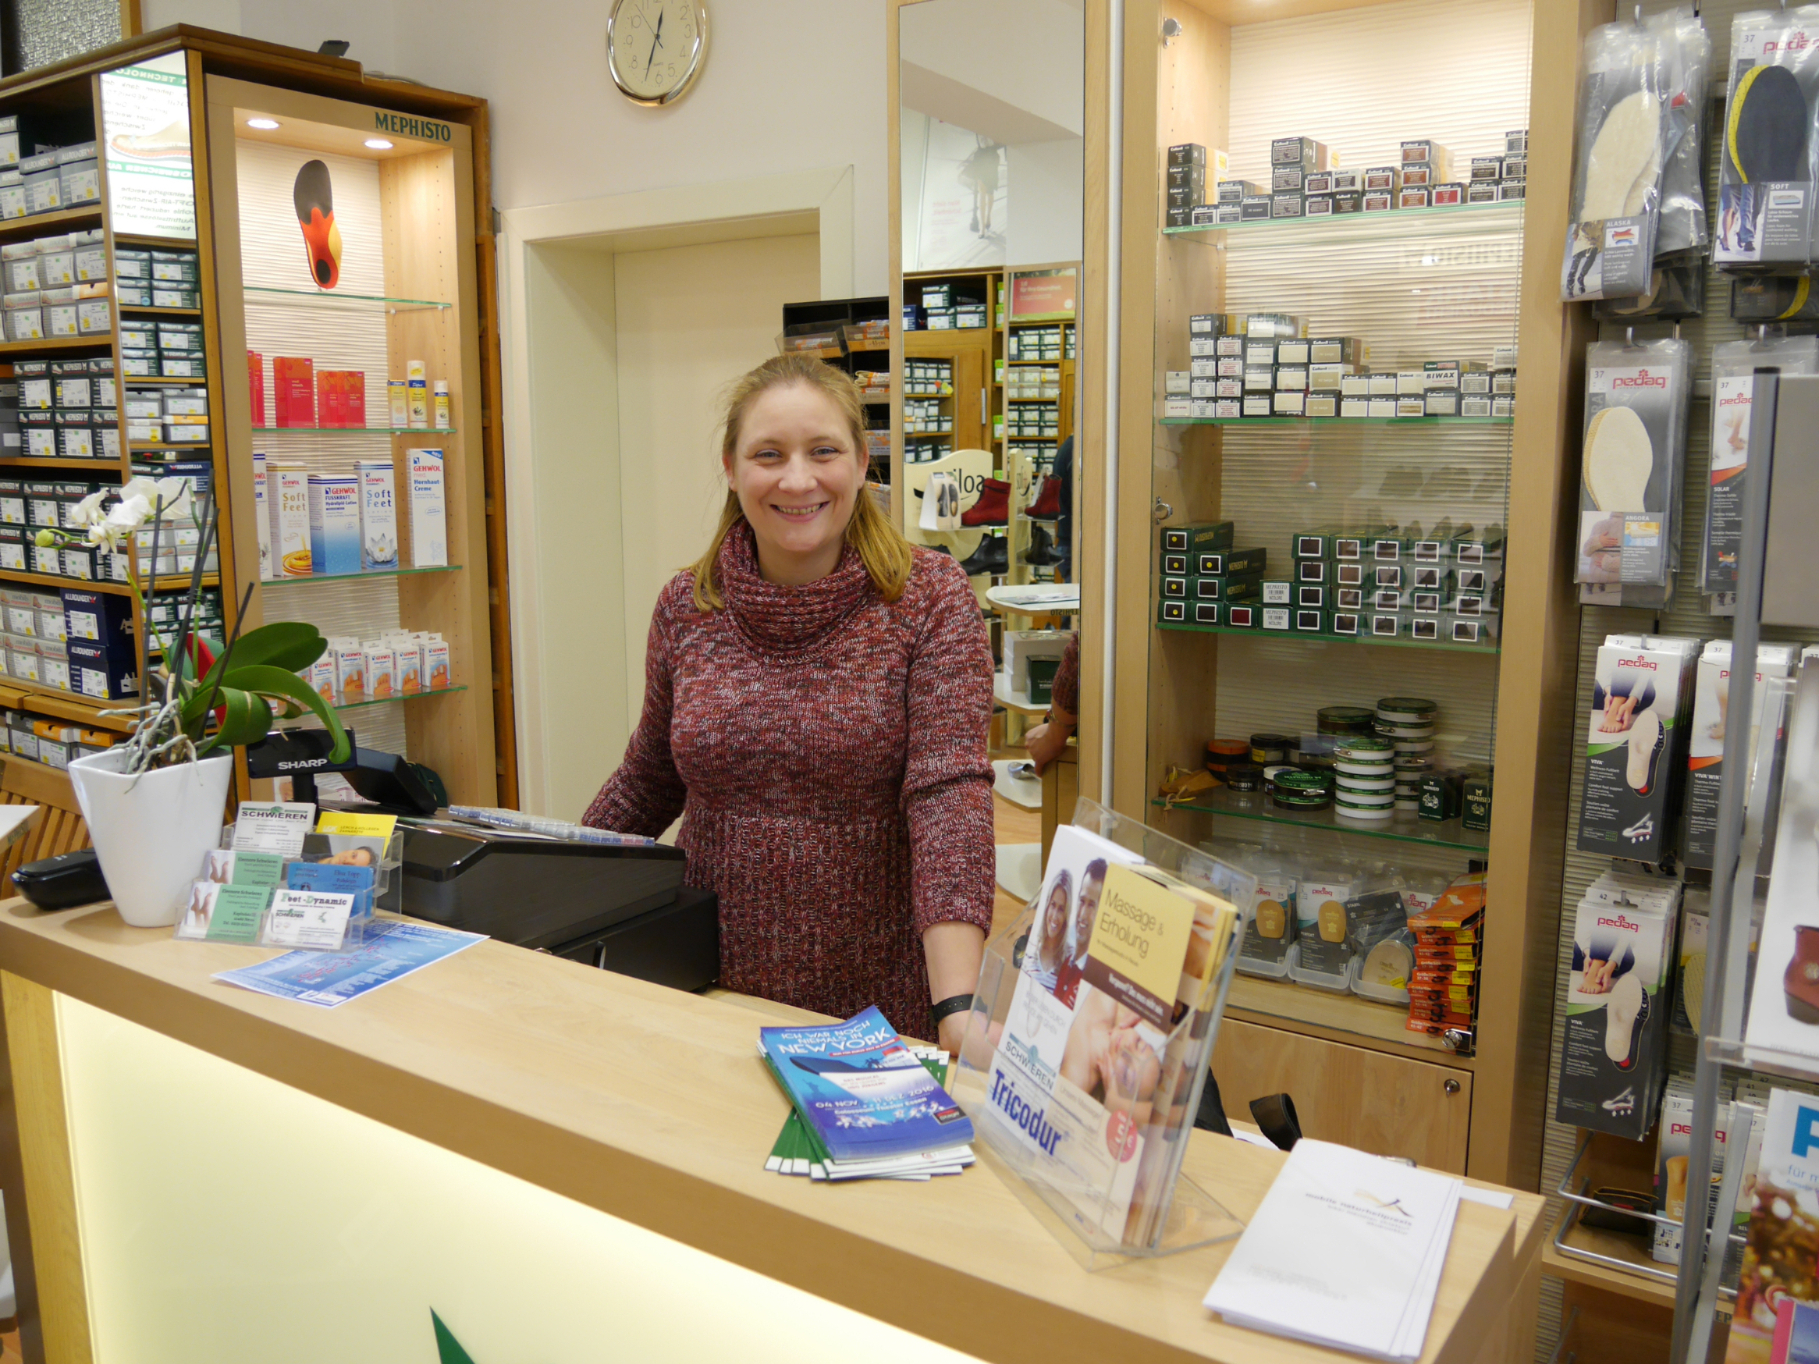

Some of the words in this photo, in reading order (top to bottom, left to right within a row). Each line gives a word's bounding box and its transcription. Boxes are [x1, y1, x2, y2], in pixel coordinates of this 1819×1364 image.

[1744, 34, 1756, 43] 37
[375, 111, 451, 142] MEPHISTO
[1607, 219, 1631, 227] ALASKA
[1426, 372, 1455, 380] BIWAX
[1594, 370, 1605, 378] 37
[1613, 373, 1666, 389] pedag
[332, 487, 357, 495] GEHWOL
[366, 490, 392, 499] Soft
[283, 493, 306, 502] Soft
[283, 503, 306, 512] Feet
[367, 499, 392, 508] Feet
[65, 593, 91, 603] ALLROUNDER
[71, 646, 95, 657] ALLROUNDER
[1618, 656, 1657, 671] pedag
[278, 758, 328, 769] SHARP
[281, 893, 302, 903] Feet
[1104, 889, 1156, 931] Massage
[1597, 915, 1638, 932] pedag
[1100, 912, 1149, 959] Erholung
[834, 1020, 871, 1037] NOCH
[777, 1043, 826, 1054] NEW
[831, 1027, 891, 1051] YORK
[798, 1035, 847, 1045] NIEMALS
[850, 1032, 863, 1040] IN
[992, 1068, 1062, 1157] Tricodur
[1788, 1163, 1806, 1179] für
